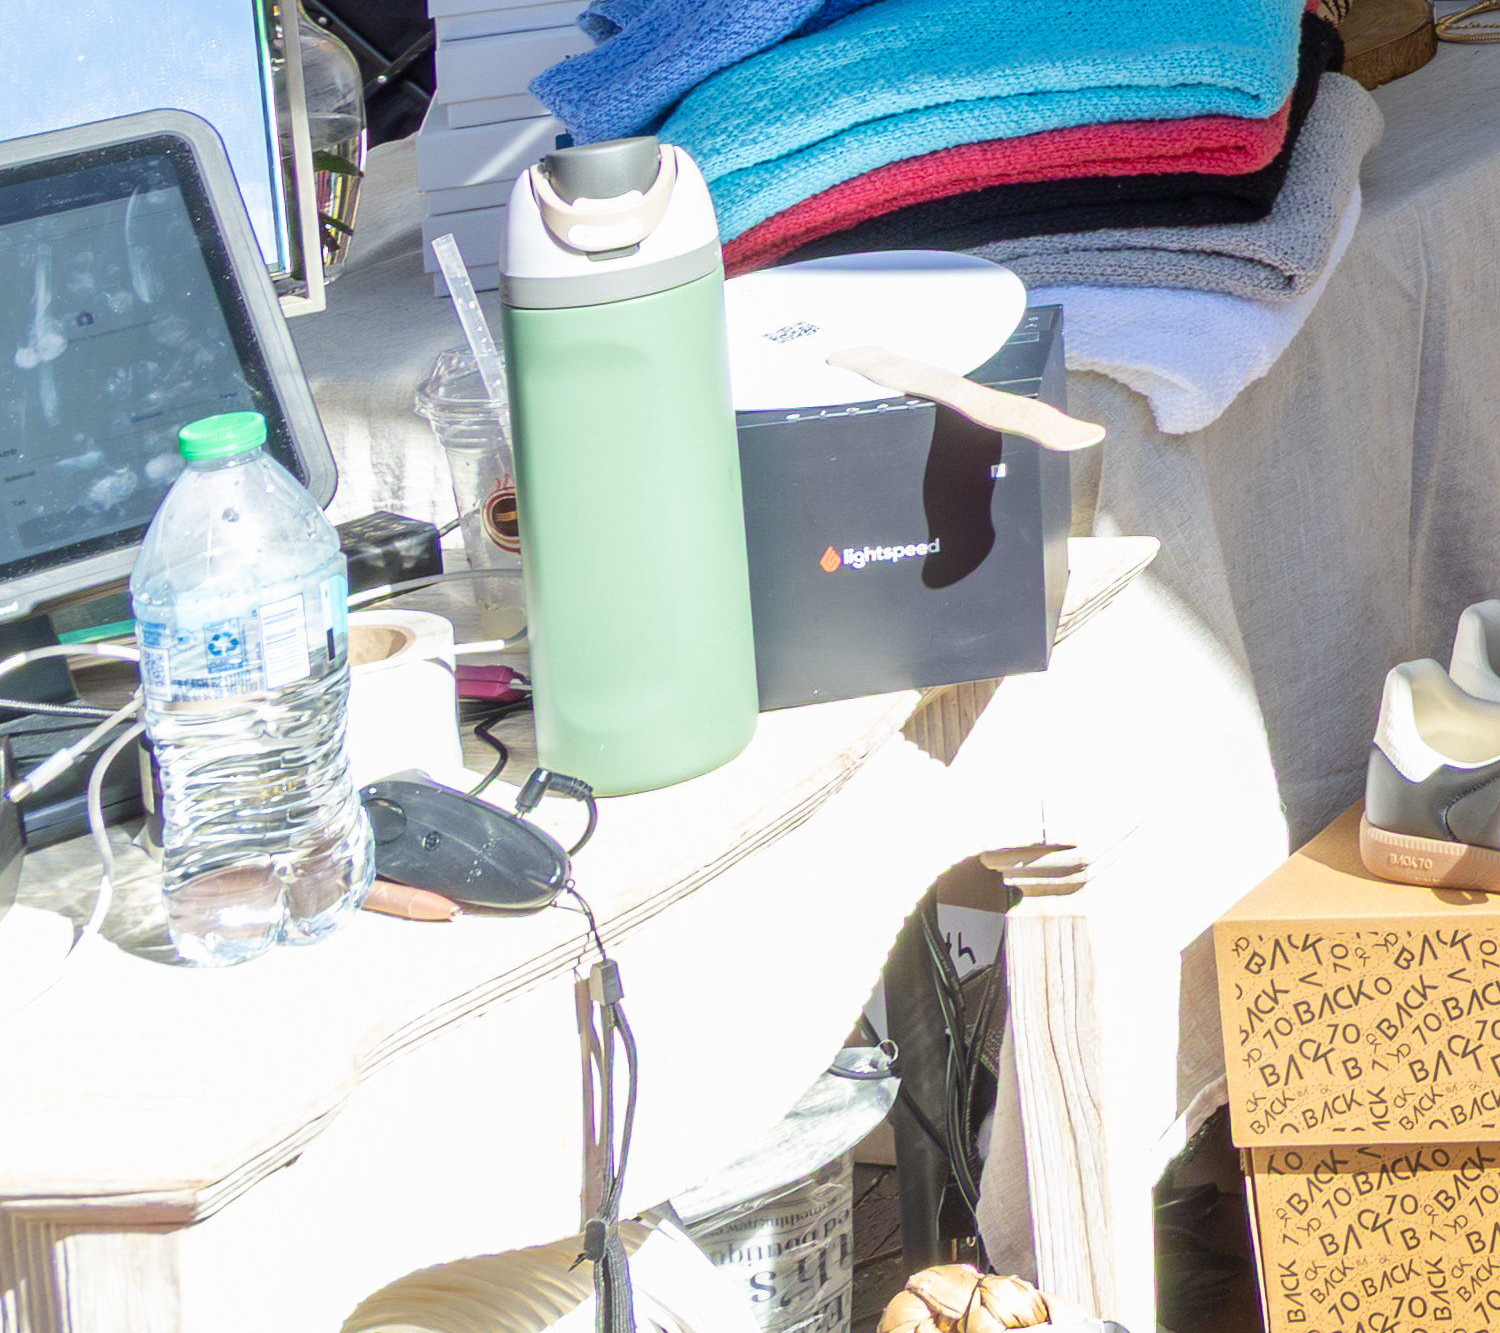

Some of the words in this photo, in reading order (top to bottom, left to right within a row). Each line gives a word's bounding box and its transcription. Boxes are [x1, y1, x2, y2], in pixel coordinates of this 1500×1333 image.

[842, 538, 941, 570] lightspeed
[1294, 979, 1374, 1025] BACK
[1376, 974, 1439, 1041] BACK
[1327, 1024, 1360, 1044] 70
[1250, 1090, 1295, 1134] BACK
[1302, 1089, 1363, 1129] BACK
[1287, 1149, 1349, 1215] BACK
[1352, 1150, 1432, 1195] BACK
[1434, 1147, 1496, 1213] BACK
[1384, 1194, 1418, 1214] 70
[1361, 1259, 1421, 1297] BACK
